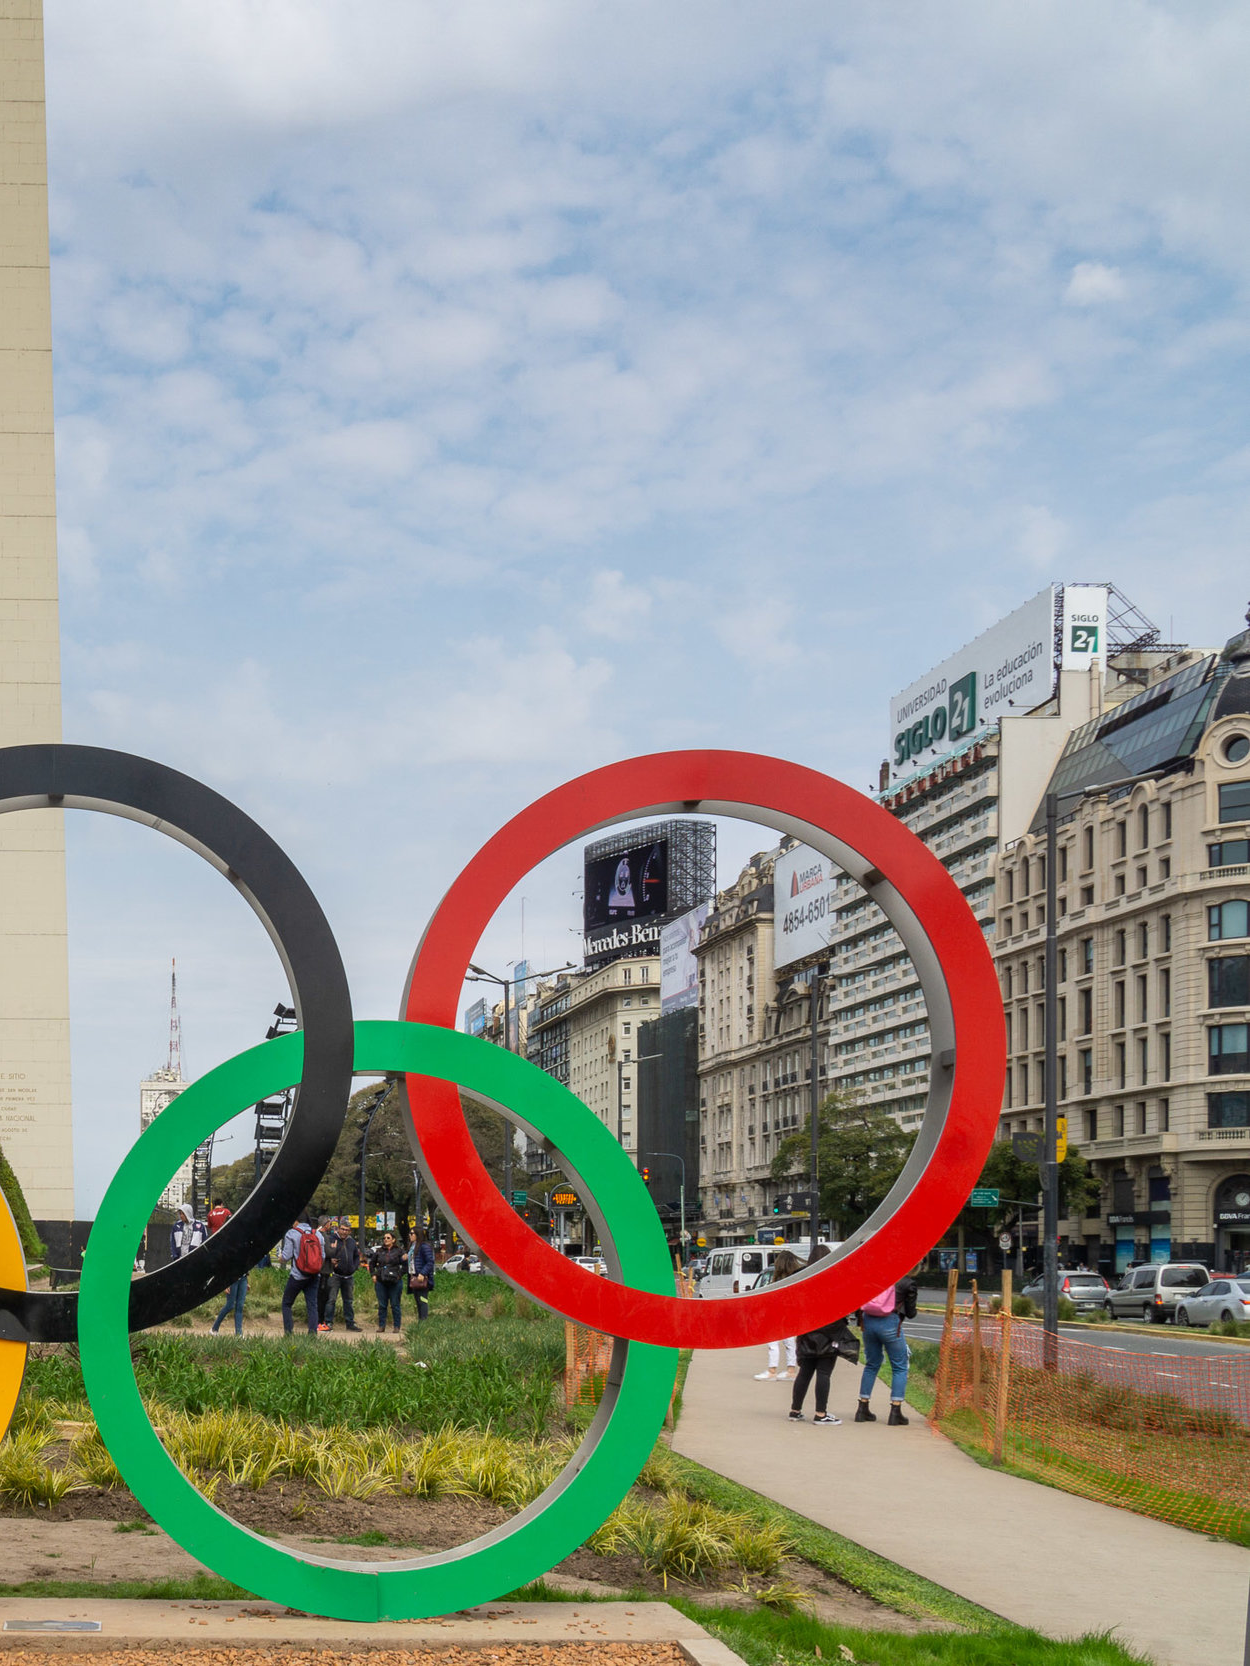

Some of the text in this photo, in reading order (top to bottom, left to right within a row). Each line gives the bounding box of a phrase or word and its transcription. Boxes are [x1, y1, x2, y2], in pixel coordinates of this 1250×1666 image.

[1071, 614, 1099, 622] SIGLO
[1073, 630, 1096, 653] 21
[984, 641, 1043, 689] La educación
[897, 678, 947, 723] UNIVERSIDAD
[984, 669, 1033, 709] evoluciona
[951, 690, 970, 732] 21
[894, 705, 947, 766] SIGLO
[799, 863, 822, 882] MARCA
[799, 873, 824, 893] URBANA
[783, 892, 830, 935] 4854-6501
